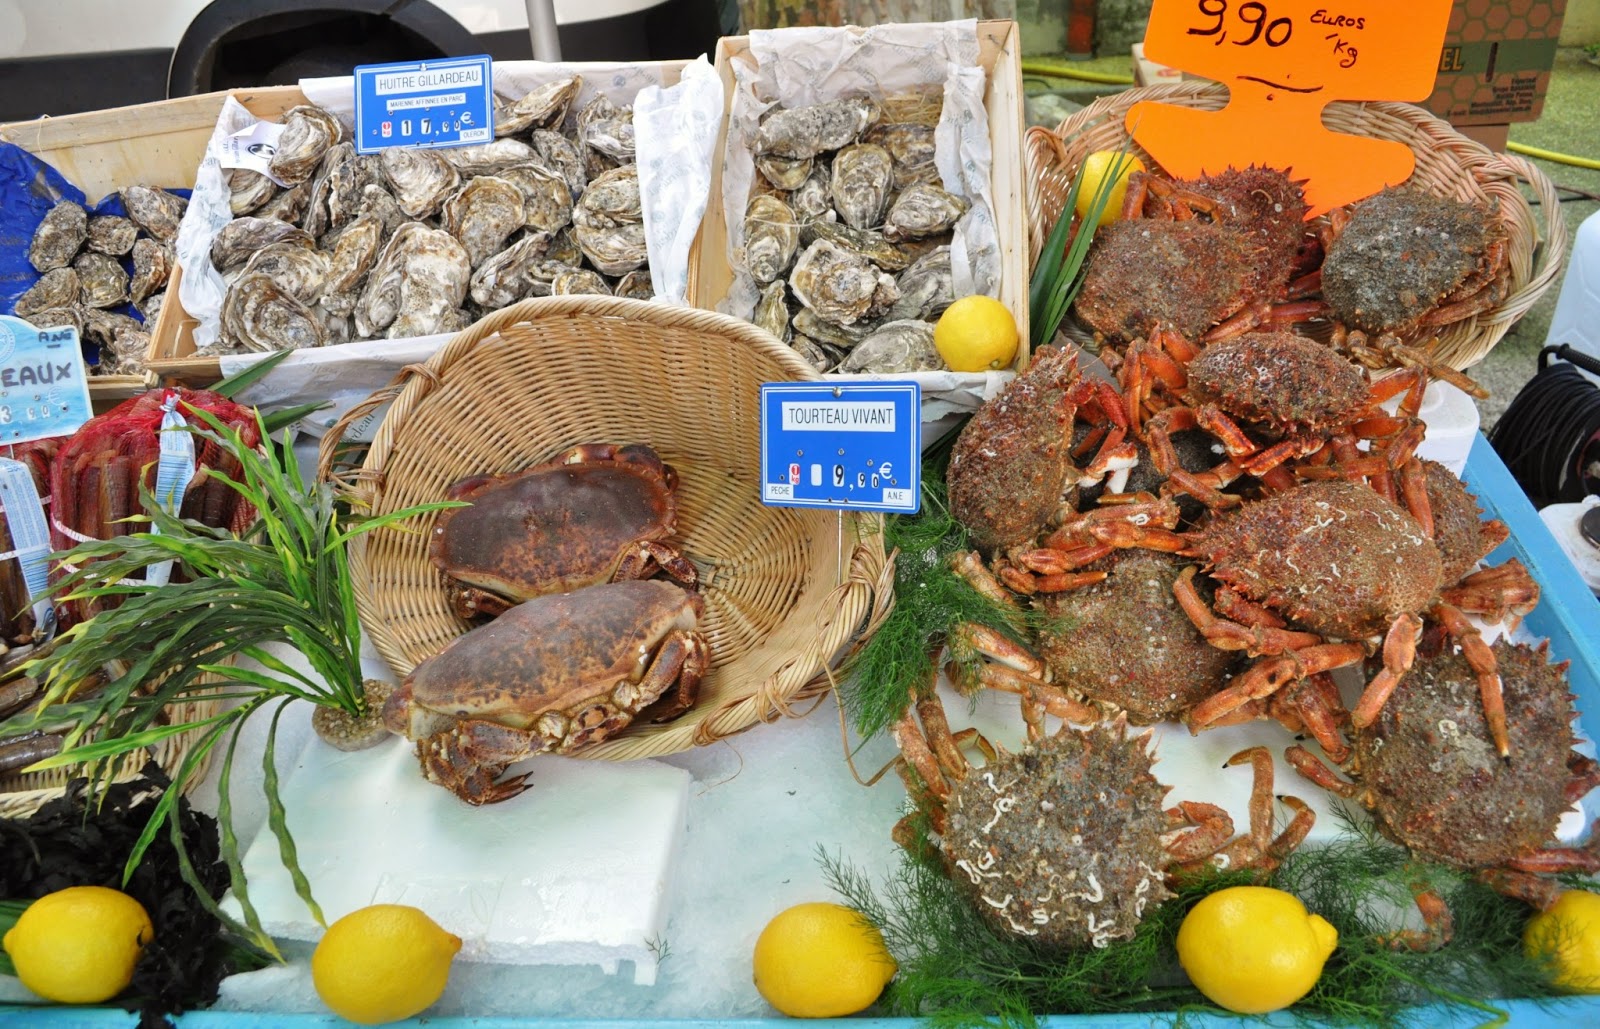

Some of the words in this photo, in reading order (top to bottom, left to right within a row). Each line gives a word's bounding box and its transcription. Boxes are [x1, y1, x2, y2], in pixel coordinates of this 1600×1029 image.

[1187, 0, 1293, 47] 9,90
[379, 76, 415, 90] HUITRE
[418, 70, 479, 87] GILLARDEAU
[390, 99, 415, 108] MARENNE
[441, 96, 449, 104] EN
[449, 95, 464, 103] PARC
[463, 130, 485, 139] OLERON
[789, 408, 848, 424] TOURTEAU
[851, 408, 893, 424] VIVANT
[770, 486, 790, 495] PECHE
